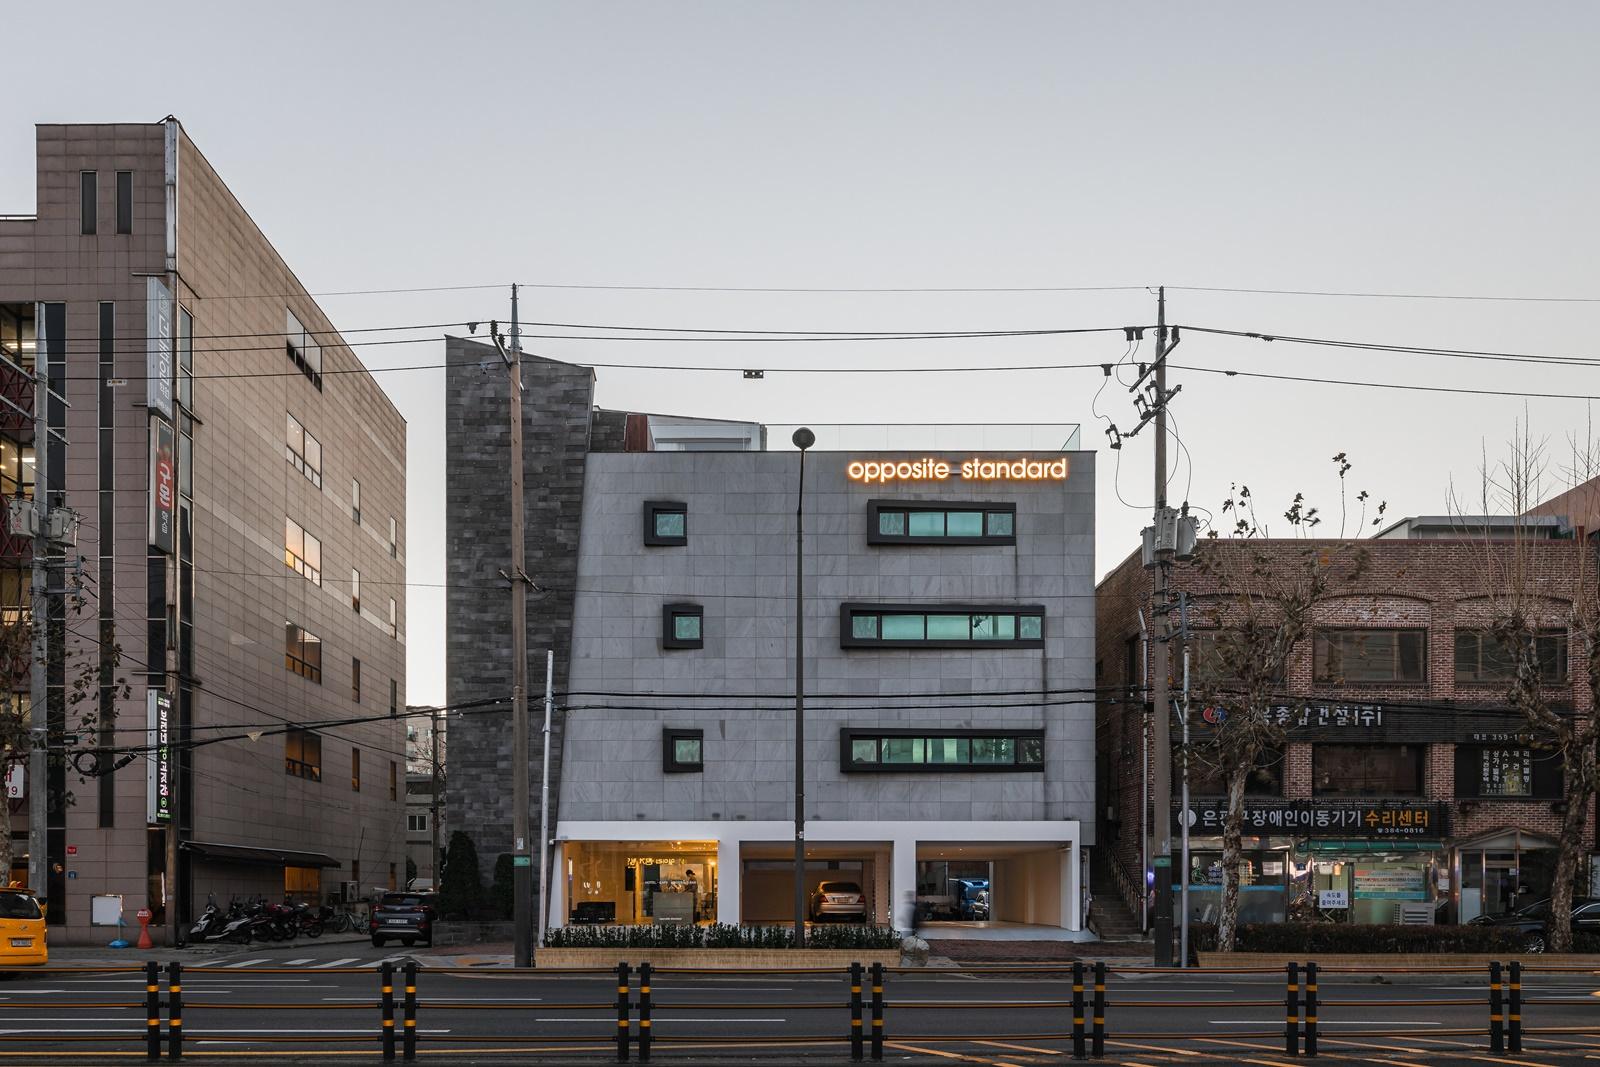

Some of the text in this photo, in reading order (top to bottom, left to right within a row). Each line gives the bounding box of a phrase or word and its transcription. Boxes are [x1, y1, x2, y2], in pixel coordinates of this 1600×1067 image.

[848, 458, 1067, 482] opposite standard
[1492, 733, 1534, 741] 359-14
[1364, 809, 1430, 829] 수리센터
